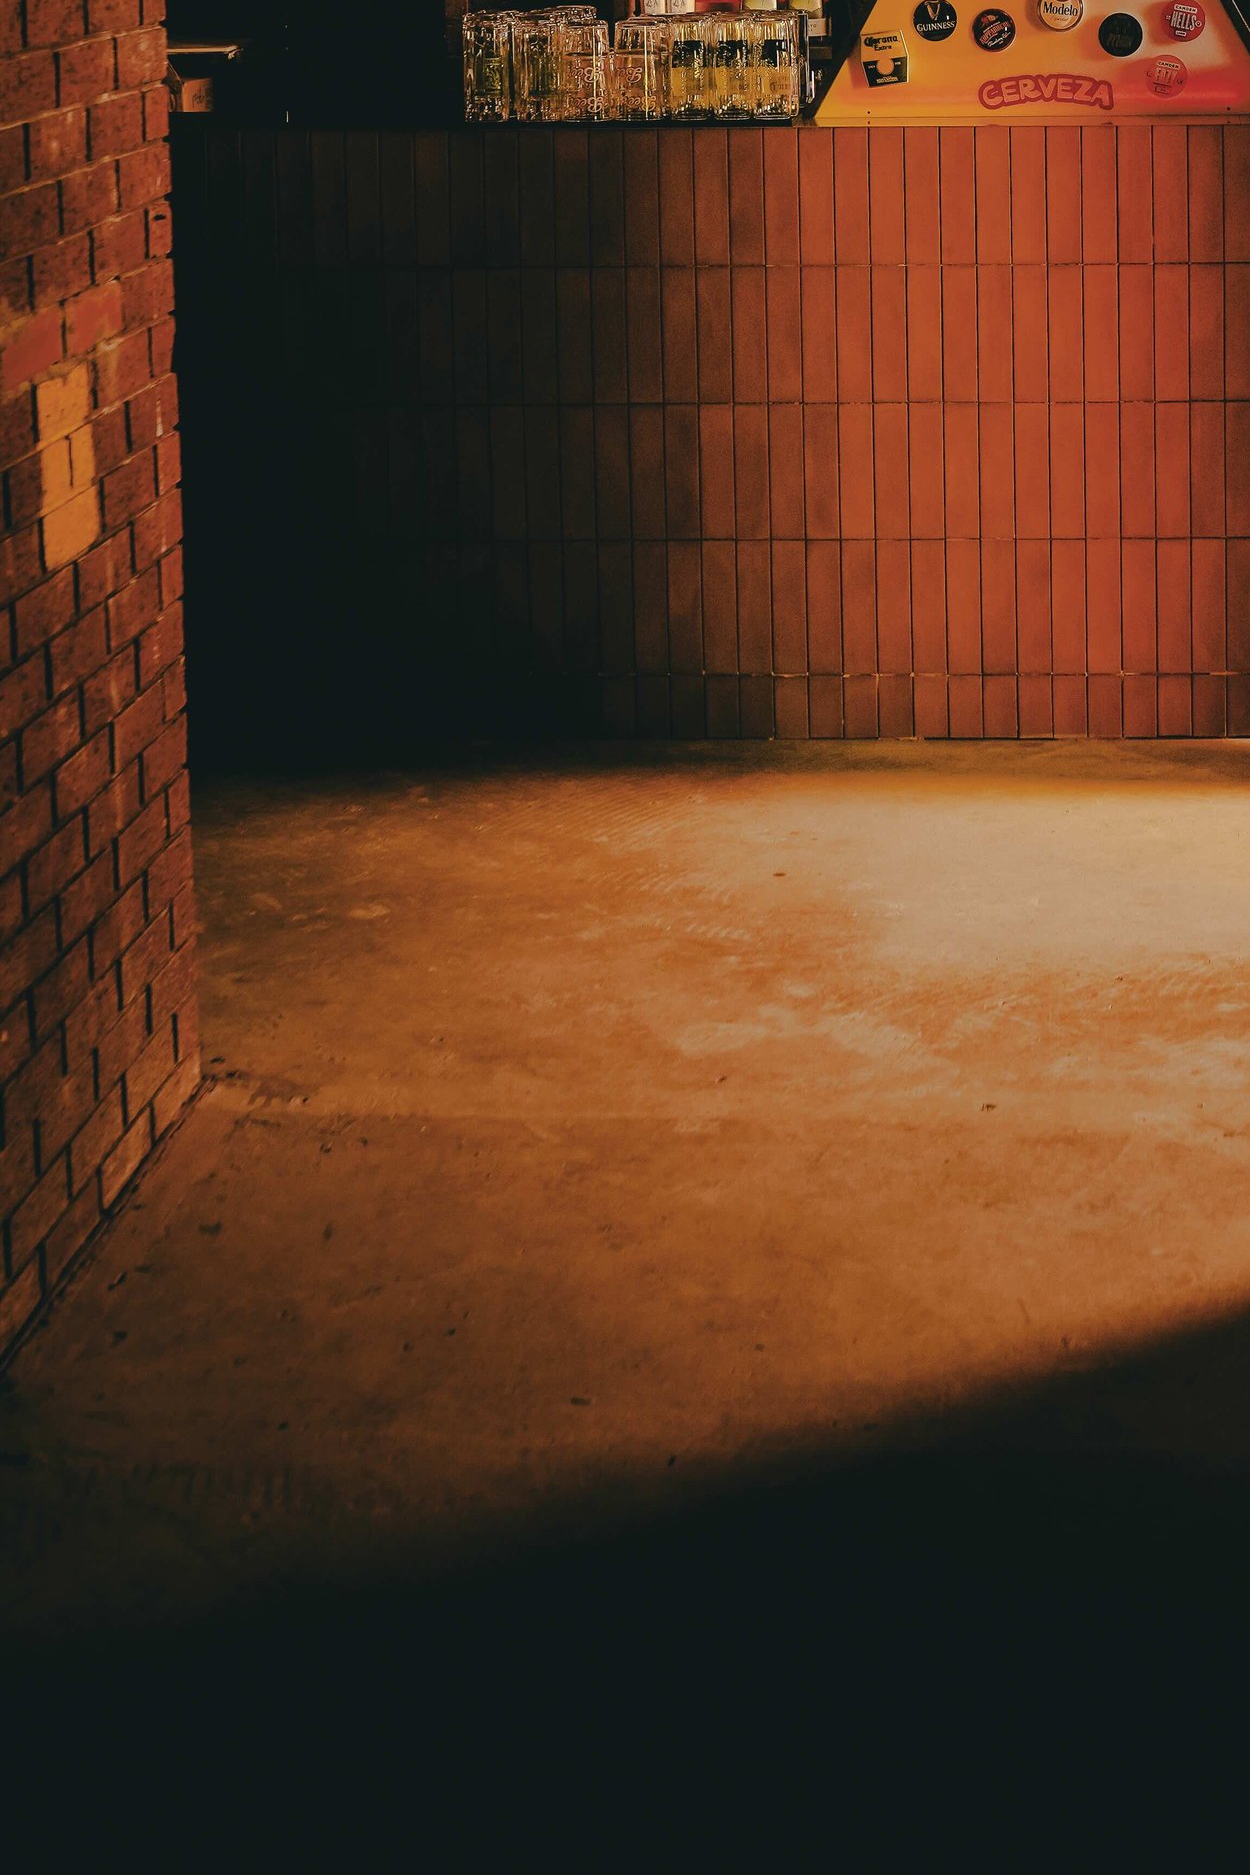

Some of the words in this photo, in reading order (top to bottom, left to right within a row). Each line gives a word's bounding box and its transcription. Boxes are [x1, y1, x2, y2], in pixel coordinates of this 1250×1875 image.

[1043, 1, 1078, 16] Modelo
[1176, 4, 1196, 13] CAMDEN
[916, 20, 956, 32] GUINNESS
[1170, 11, 1197, 31] HELLS
[1158, 61, 1179, 69] CAMDEN
[979, 75, 1113, 110] CERVEZA
